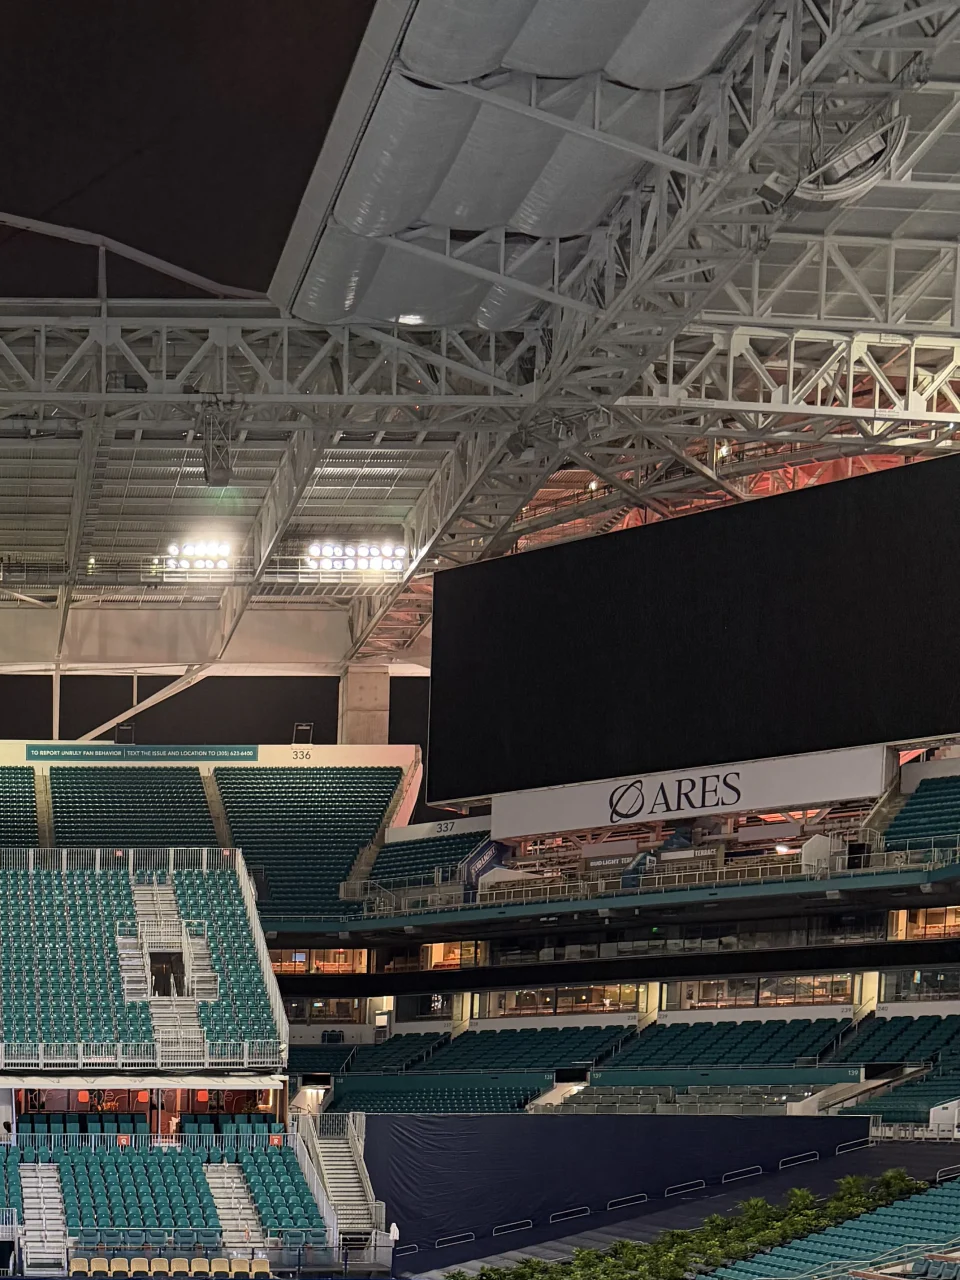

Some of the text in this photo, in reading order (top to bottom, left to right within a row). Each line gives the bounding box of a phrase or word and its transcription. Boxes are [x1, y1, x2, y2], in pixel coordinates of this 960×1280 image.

[291, 750, 311, 760] 336
[647, 771, 741, 815] ARES
[436, 822, 455, 833] 337
